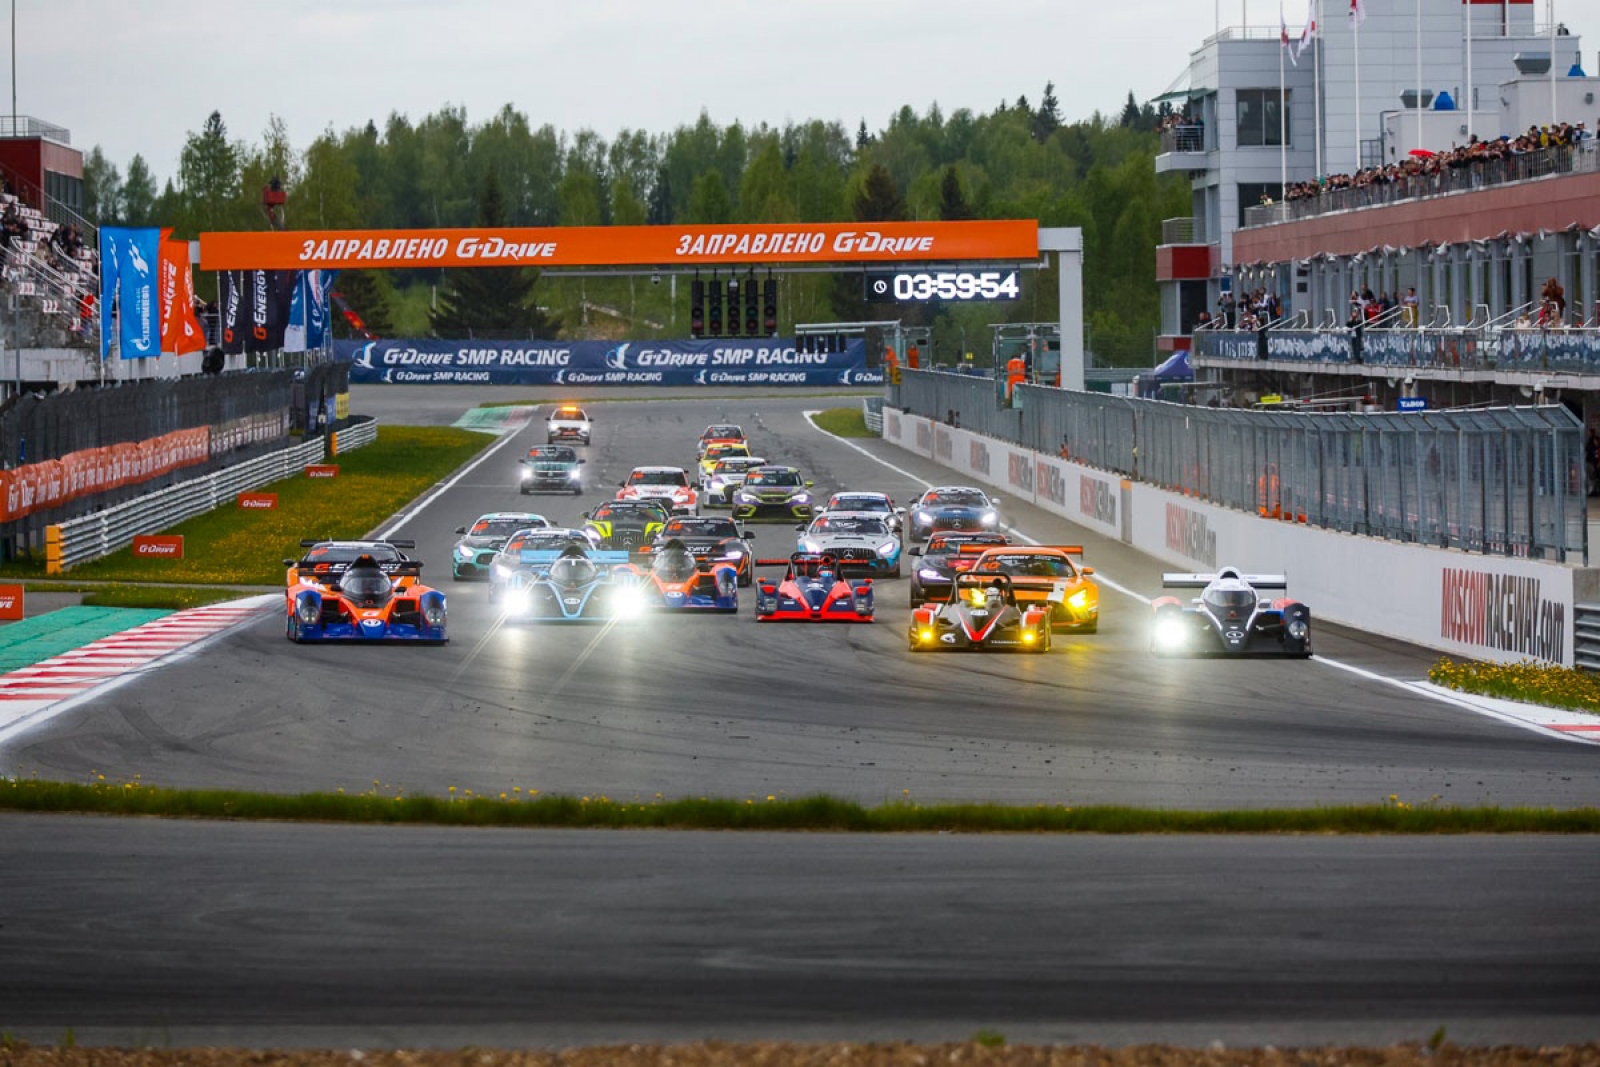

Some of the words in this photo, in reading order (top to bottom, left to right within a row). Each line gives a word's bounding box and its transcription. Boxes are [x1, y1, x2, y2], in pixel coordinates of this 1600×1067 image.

[299, 238, 449, 261] ЗАПРАВЛЕНО
[675, 232, 825, 255] ЗАПРАВЛЕНО
[894, 271, 1019, 300] 03:59:54
[456, 348, 498, 365] SMP
[500, 348, 570, 365] RACING
[711, 350, 753, 365] SMP
[755, 349, 828, 365] RACING
[433, 371, 454, 381] SMP
[454, 371, 490, 381] RACING
[604, 372, 626, 382] SMP
[627, 372, 662, 382] RACING
[747, 372, 769, 382] SMP
[769, 372, 807, 382] RACING
